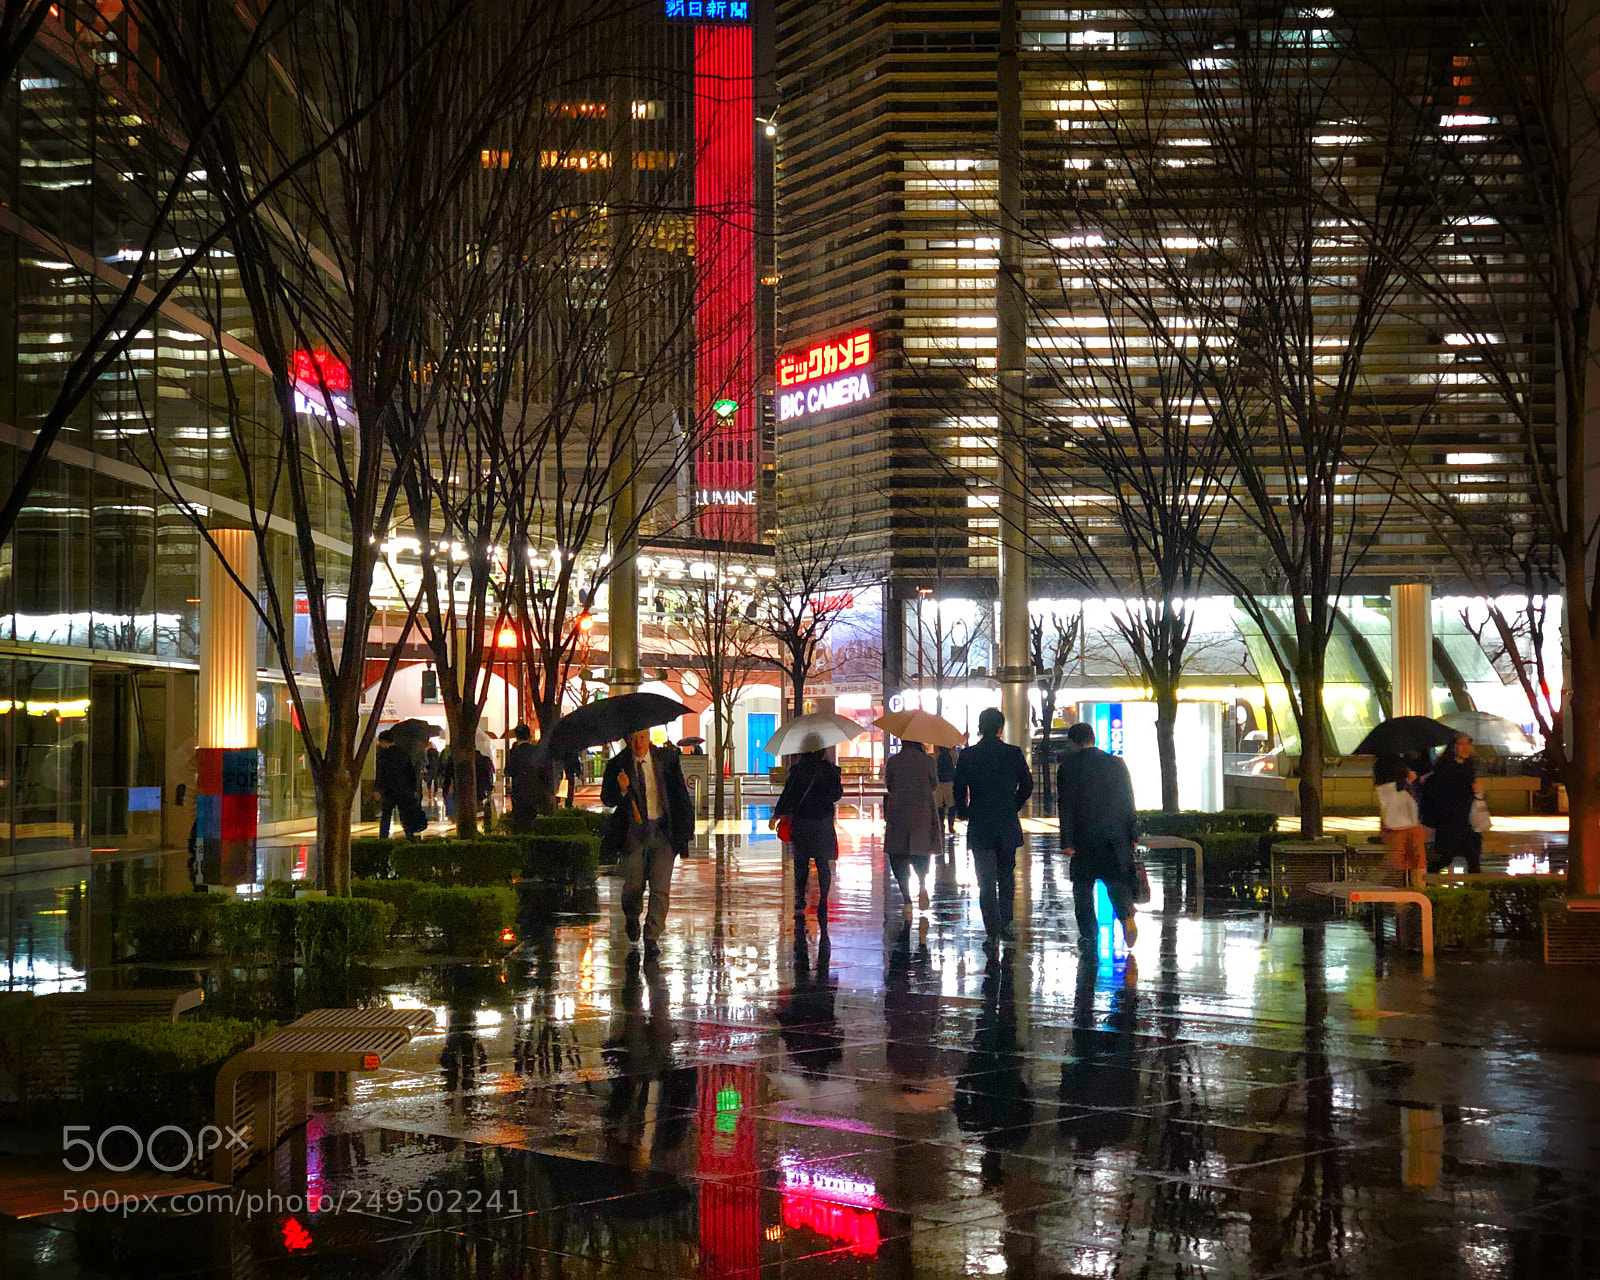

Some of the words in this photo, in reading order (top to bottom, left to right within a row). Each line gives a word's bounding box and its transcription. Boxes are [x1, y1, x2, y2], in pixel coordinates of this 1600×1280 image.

[665, 0, 748, 19] 朝日新聞
[780, 332, 871, 386] ビックカメラ
[780, 391, 805, 421] BIC
[807, 373, 871, 413] CAMERA
[696, 489, 757, 506] LUMINE
